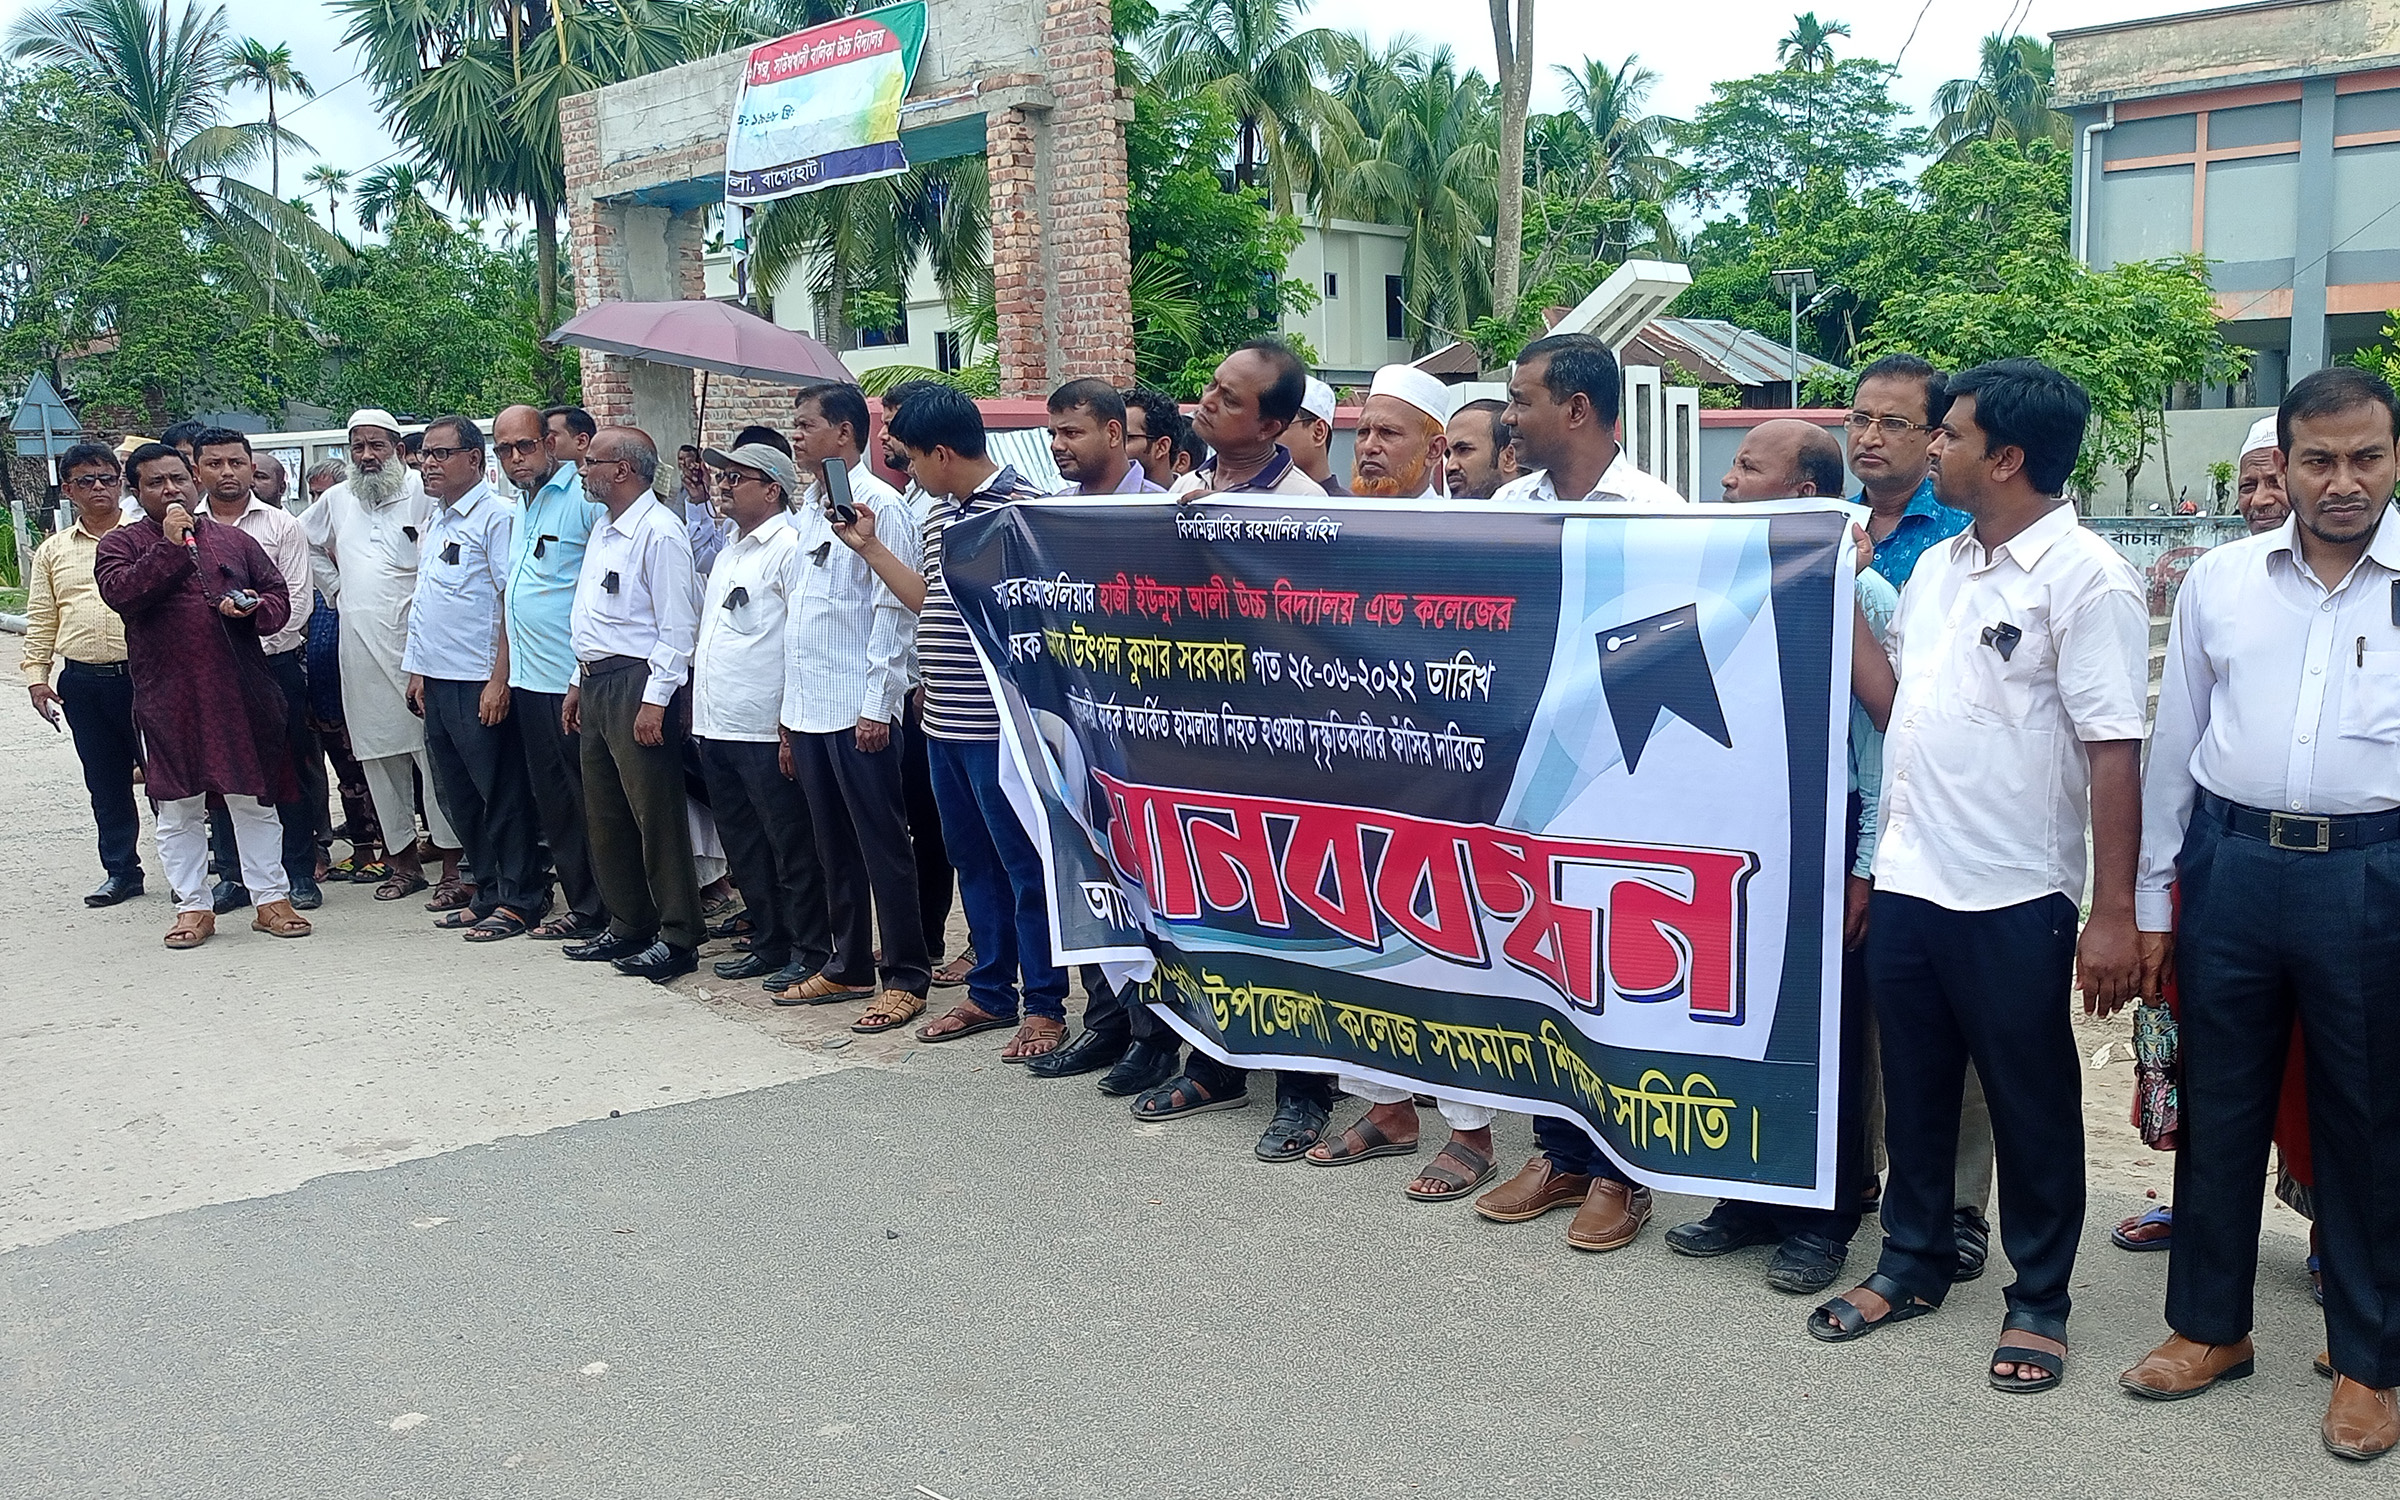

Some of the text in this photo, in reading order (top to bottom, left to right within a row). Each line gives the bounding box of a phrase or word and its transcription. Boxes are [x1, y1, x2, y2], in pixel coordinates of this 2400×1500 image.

[853, 28, 886, 55] বিদ্যালয়
[1175, 511, 1342, 544] বিসমিল্লাহির রহমানির রহিম
[1098, 571, 1131, 618] হাজী
[1133, 574, 1182, 626] ইউনুস
[1185, 574, 1229, 620] আলী
[1232, 577, 1268, 619] উচ্চ
[1271, 577, 1360, 627] বিদ্যালয়
[1412, 594, 1517, 632] কলেজের
[1068, 620, 1122, 676] উৎপল
[1124, 634, 1173, 691] কুমার
[1175, 637, 1247, 685] সরকার
[1251, 645, 1282, 687] গত
[1287, 652, 1417, 704] ২৫-০৬-২০২২
[1424, 649, 1497, 703] তারিখ
[1124, 696, 1170, 741] অতর্কিত
[1171, 706, 1220, 749] হামলায়
[1221, 701, 1258, 755] নিহত
[1259, 713, 1306, 757] হওয়ায়
[1387, 714, 1433, 767] ফাঁসির
[1432, 721, 1486, 773] দাবিতে
[1090, 766, 1760, 1025] মানববন্ধন
[1201, 967, 1333, 1044] উপজেলা
[1329, 999, 1424, 1065] কলেজ
[1538, 1018, 1606, 1125] শিক্ষক
[1607, 1069, 1738, 1156] সমিতি
